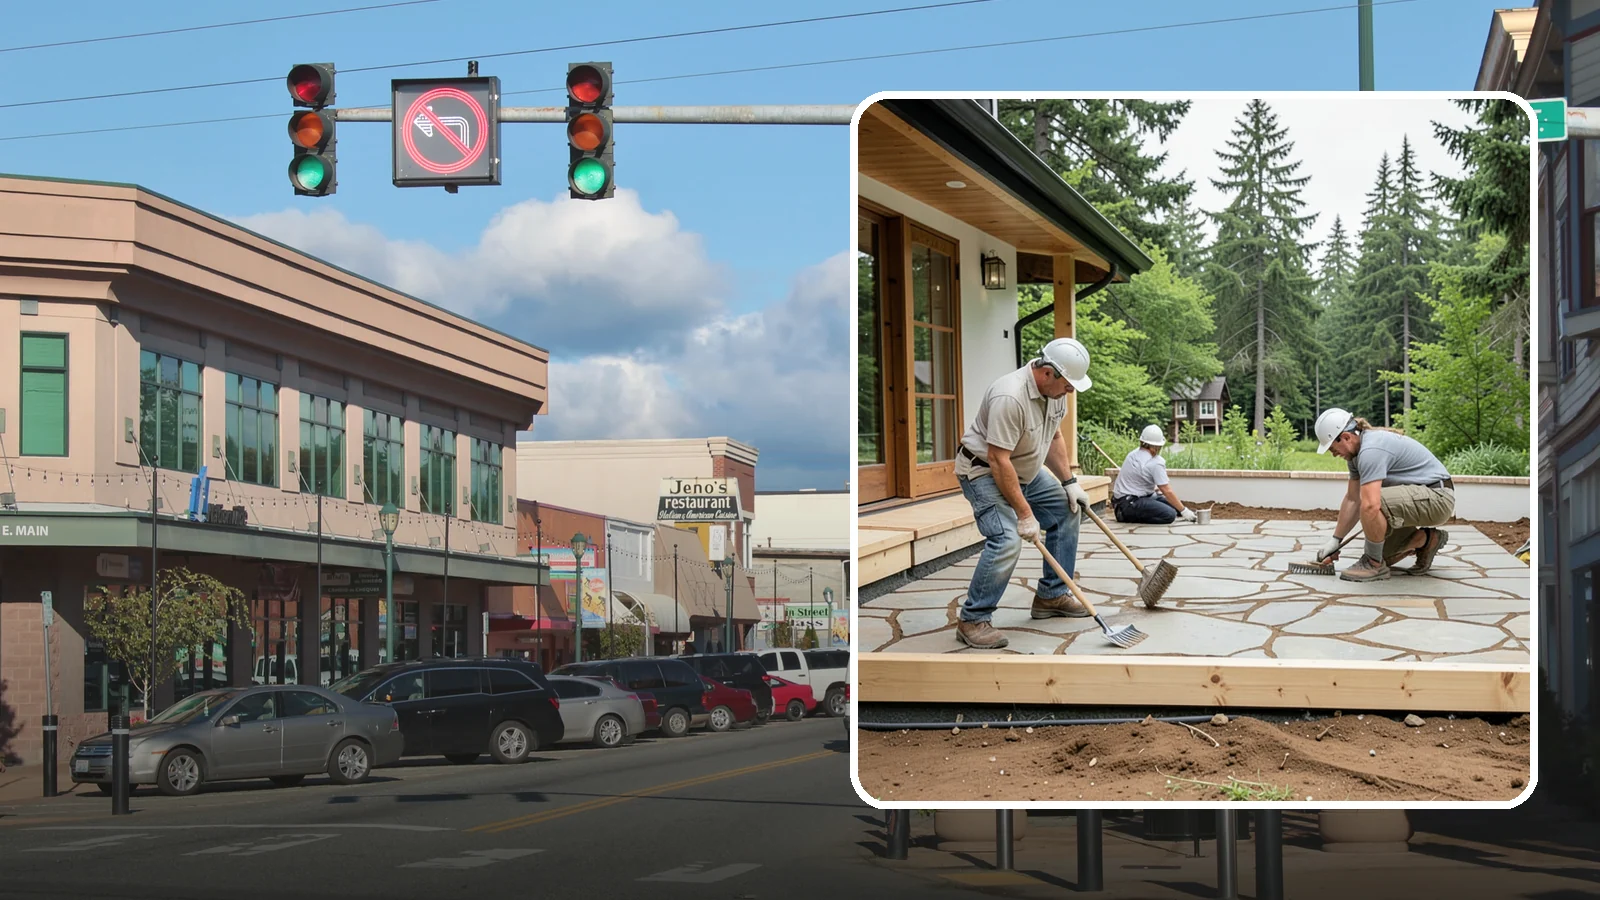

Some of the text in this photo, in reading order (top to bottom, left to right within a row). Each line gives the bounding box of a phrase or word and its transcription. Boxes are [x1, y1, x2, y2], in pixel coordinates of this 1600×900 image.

[669, 480, 727, 494] Jeno's
[665, 496, 731, 509] restaurant
[658, 510, 681, 519] Italian
[686, 510, 714, 519] American
[715, 510, 737, 519] Cuisine
[2, 525, 49, 536] E. MAIN
[798, 608, 828, 616] Street
